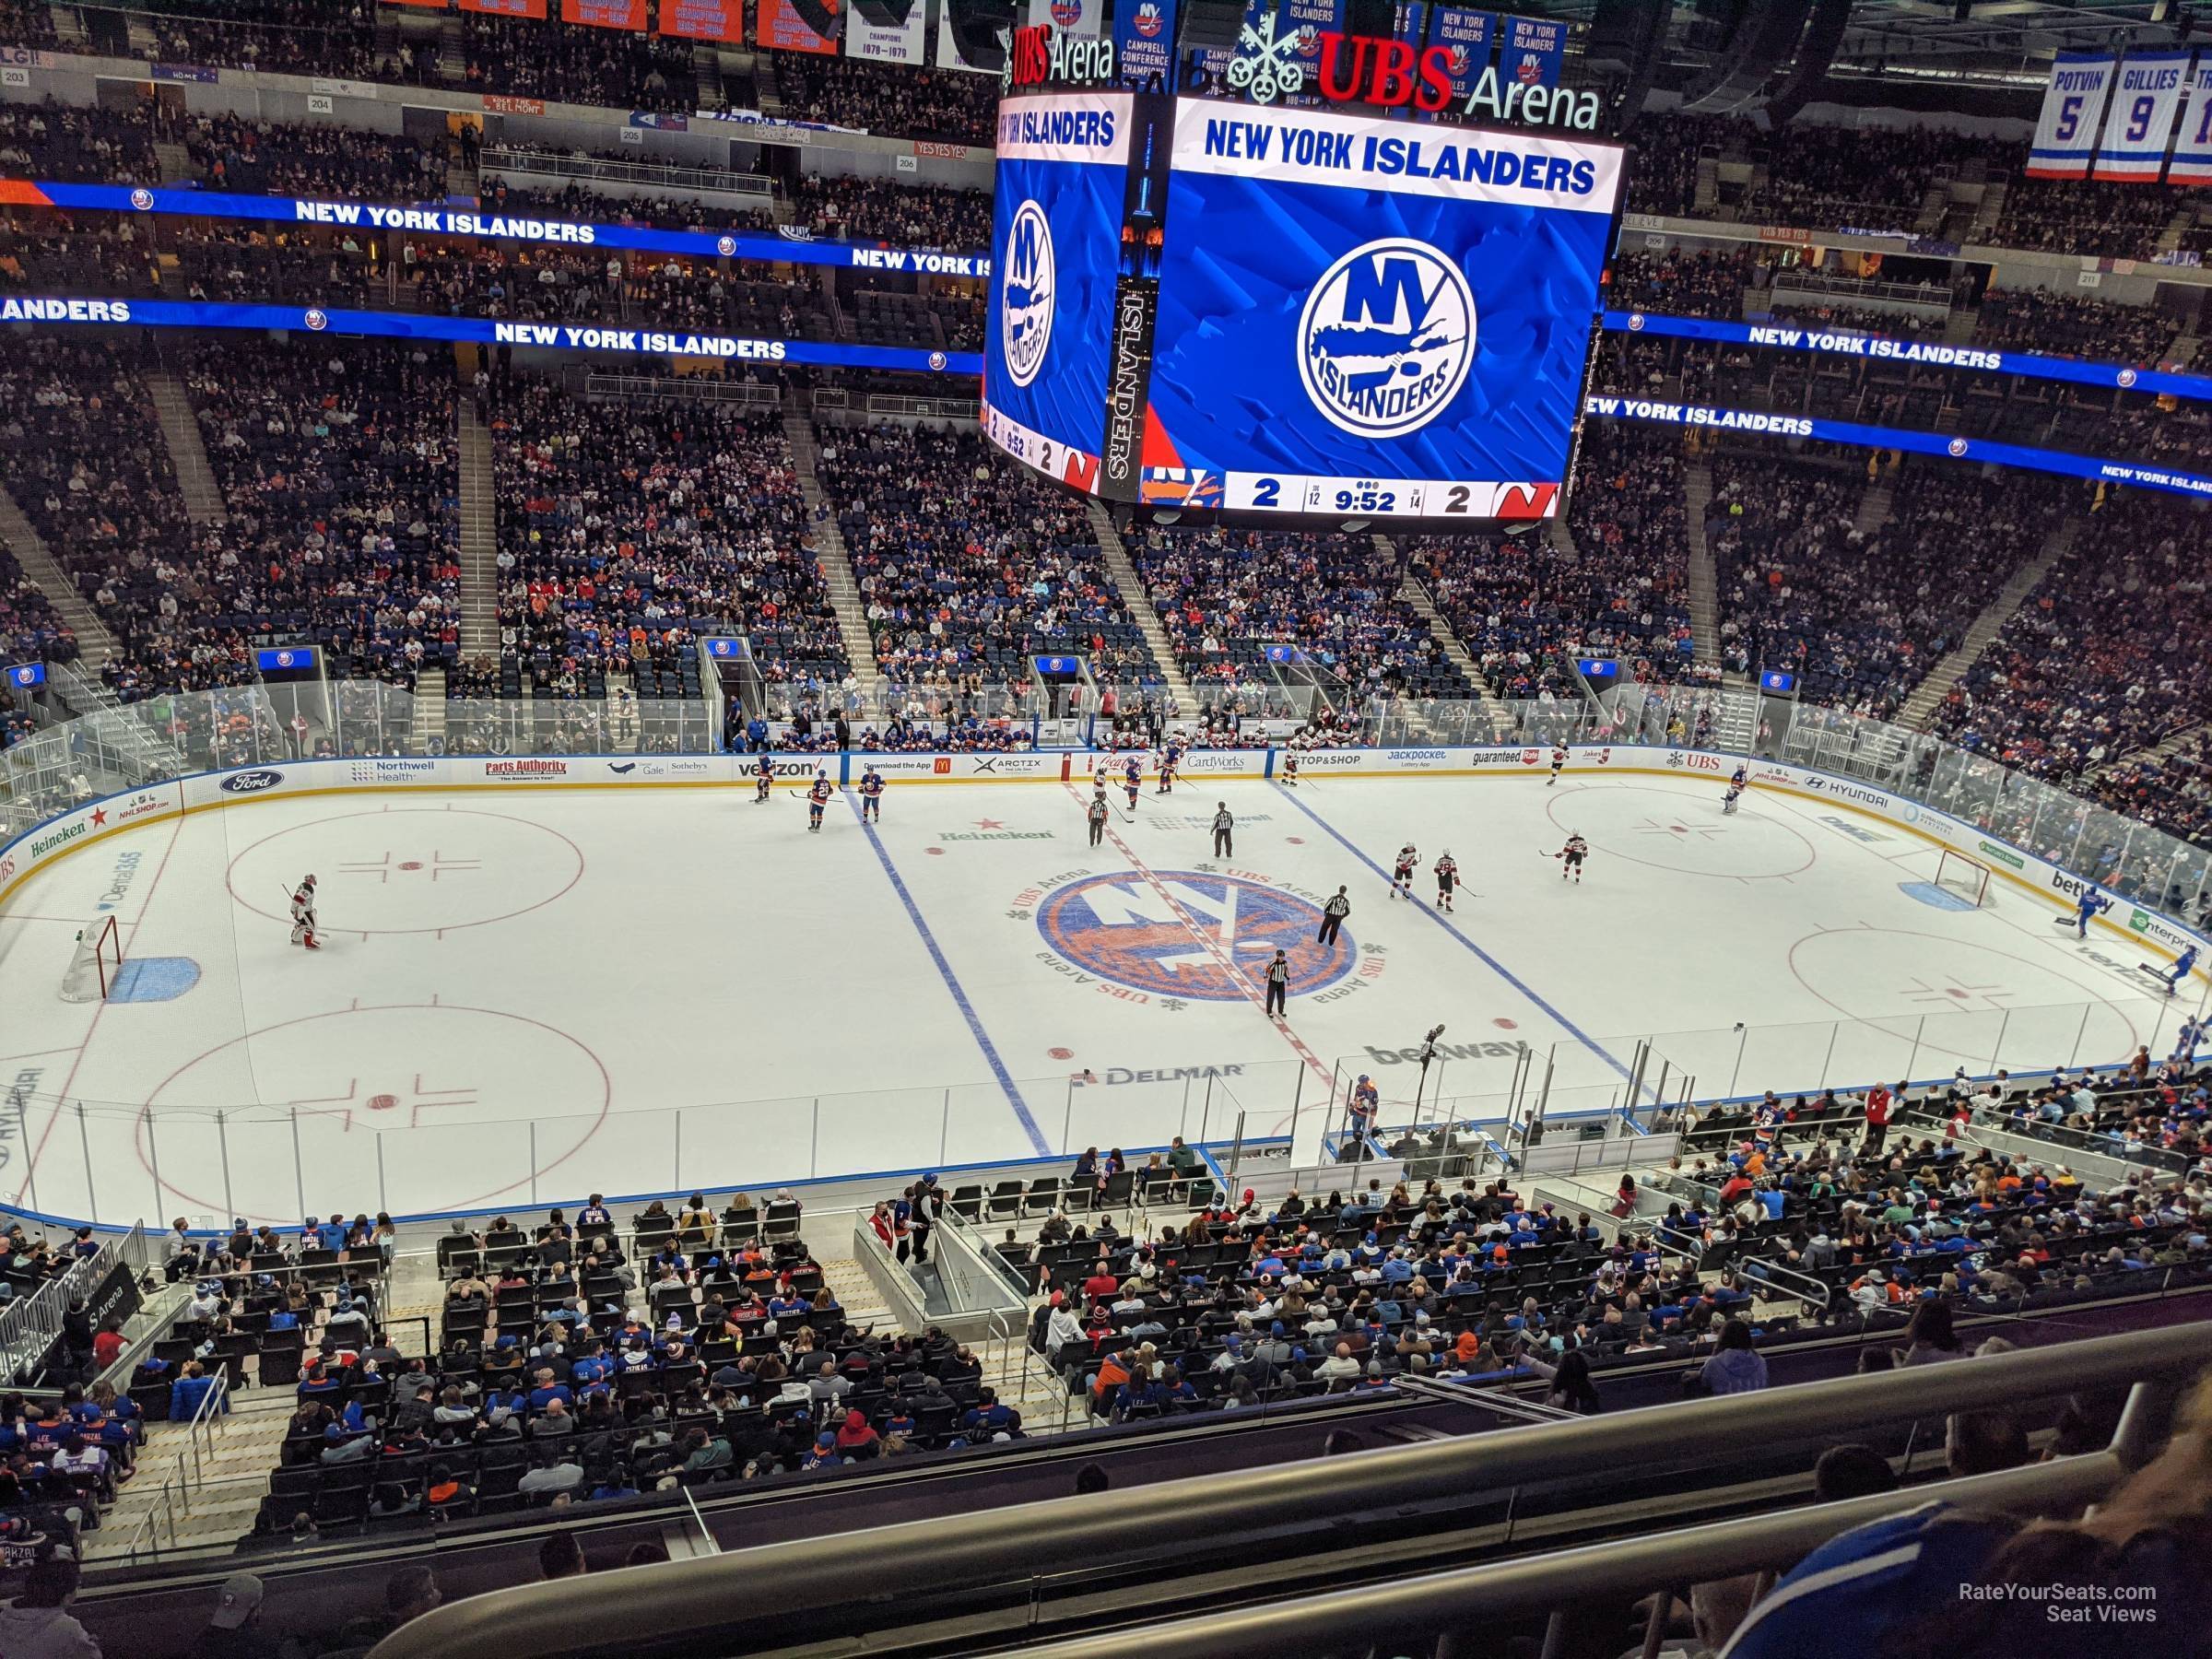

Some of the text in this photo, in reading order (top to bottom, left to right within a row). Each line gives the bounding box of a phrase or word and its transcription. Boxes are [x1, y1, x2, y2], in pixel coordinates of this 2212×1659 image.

[1289, 6, 1335, 23] ISLANDERS
[1443, 12, 1486, 29] NEW YORK
[868, 32, 901, 43] CHAMPIONS
[1441, 25, 1484, 42] ISLANDERS
[1516, 21, 1558, 39] NEW YORK
[1014, 23, 1113, 86] UBS Arena
[1126, 40, 1166, 54] CAMPBELL
[1513, 36, 1556, 53] ISLANDERS
[1122, 52, 1169, 66] CONFERENCE
[6, 72, 24, 83] 203
[172, 71, 197, 81] HOME
[1319, 30, 1600, 130] UBS Arena
[2053, 70, 2105, 91] POTVIN
[2123, 68, 2180, 90] GILLIES
[311, 100, 329, 110] 204
[495, 101, 541, 114] BELMONT
[2054, 96, 2084, 141] 5
[2125, 95, 2155, 142] 9
[624, 131, 639, 140] 205
[1022, 111, 1115, 147] ISLANDERS
[917, 141, 967, 158] YES YES YES
[1206, 120, 1594, 194] NEW YORK ISLANDERS
[900, 159, 914, 169] 206
[296, 201, 595, 243] NEW YORK ISLANDERS
[1794, 229, 1807, 240] YES
[853, 248, 906, 269] NEW
[912, 253, 971, 275] YORK
[2082, 276, 2095, 284] 211
[0, 299, 130, 323] ANDERS
[495, 323, 786, 360] NEW YORK ISLANDERS
[1748, 326, 2001, 370] NEW YORK ISLANDERS
[1108, 297, 1145, 480] ISLANDERS
[1317, 356, 1450, 419] ISLANDERS
[992, 412, 997, 440] 2
[1586, 397, 1813, 436] EW YORK ISLANDERS
[1006, 430, 1025, 458] 9:52
[1041, 441, 1052, 472] 2
[2101, 465, 2170, 485] NEW YORK
[1252, 477, 1281, 508] 2
[1309, 492, 1321, 505] 12
[1335, 490, 1396, 512] 9:52
[1409, 495, 1421, 509] 14
[1444, 485, 1471, 513] 2
[376, 760, 434, 772] Northwell
[486, 759, 568, 774] Parts Authority
[671, 761, 708, 771] Sotheby's
[916, 762, 931, 771] App
[997, 759, 1041, 768] ARCTIX
[1187, 755, 1244, 771] CardWorks
[1295, 755, 1361, 766] STOP&SHOP
[1473, 749, 1538, 766] guaranteed Rate
[1687, 754, 1721, 771] UBS
[377, 771, 415, 782] Health
[642, 766, 665, 775] Gale
[738, 759, 813, 777] veizon
[232, 771, 273, 791] Ford
[1830, 782, 1888, 809] HYUNDAI
[30, 820, 87, 859] Heineken
[938, 830, 1055, 841] Heineken
[101, 849, 144, 903] Dental365
[1013, 868, 1092, 908] UBS Arena
[1226, 867, 1325, 906] UBS Aren
[2052, 870, 2116, 915] bety
[2133, 911, 2203, 959] enterprie
[1035, 952, 1097, 984] Arena
[2076, 947, 2171, 996] verizo
[1312, 957, 1386, 1005] UBS Arena
[1096, 982, 1150, 1005] UBS
[1106, 1063, 1245, 1086] DELMAR
[100, 1285, 124, 1322] Arena
[37, 1434, 50, 1442] LEE
[4, 1547, 38, 1559] ARZAL
